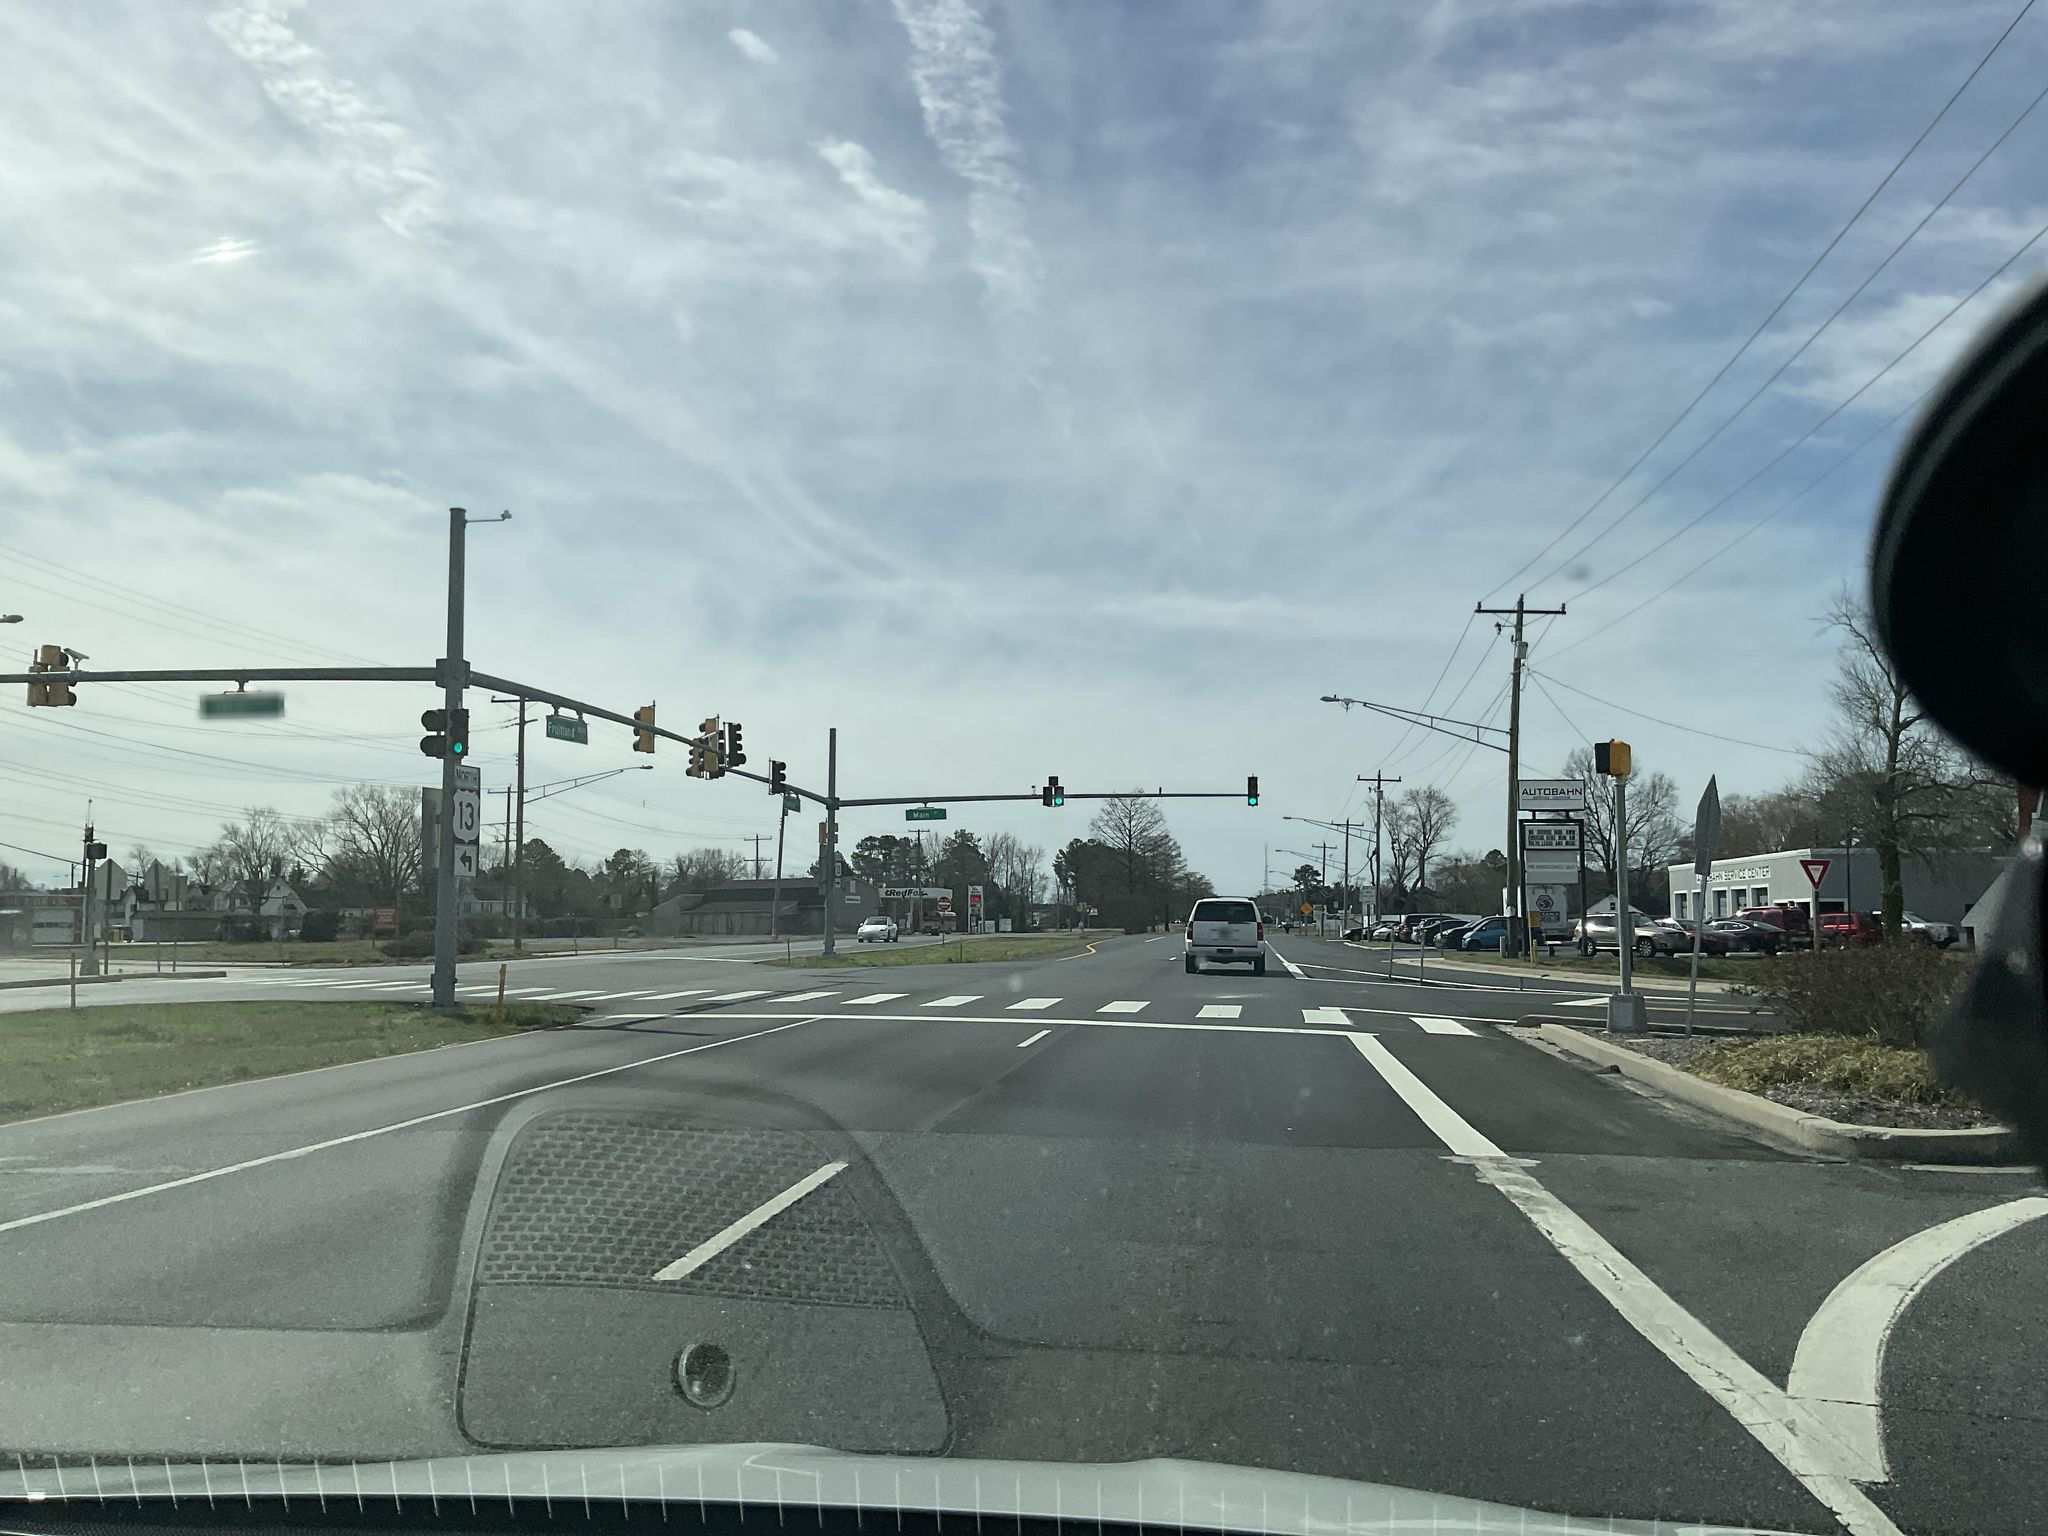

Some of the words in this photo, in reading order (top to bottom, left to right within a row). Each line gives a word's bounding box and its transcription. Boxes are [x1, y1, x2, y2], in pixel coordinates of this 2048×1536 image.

[1521, 788, 1583, 796] AUTOBAHN
[459, 801, 474, 830] 13
[1725, 870, 1747, 881] SERVICE
[1748, 866, 1770, 878] CENTER
